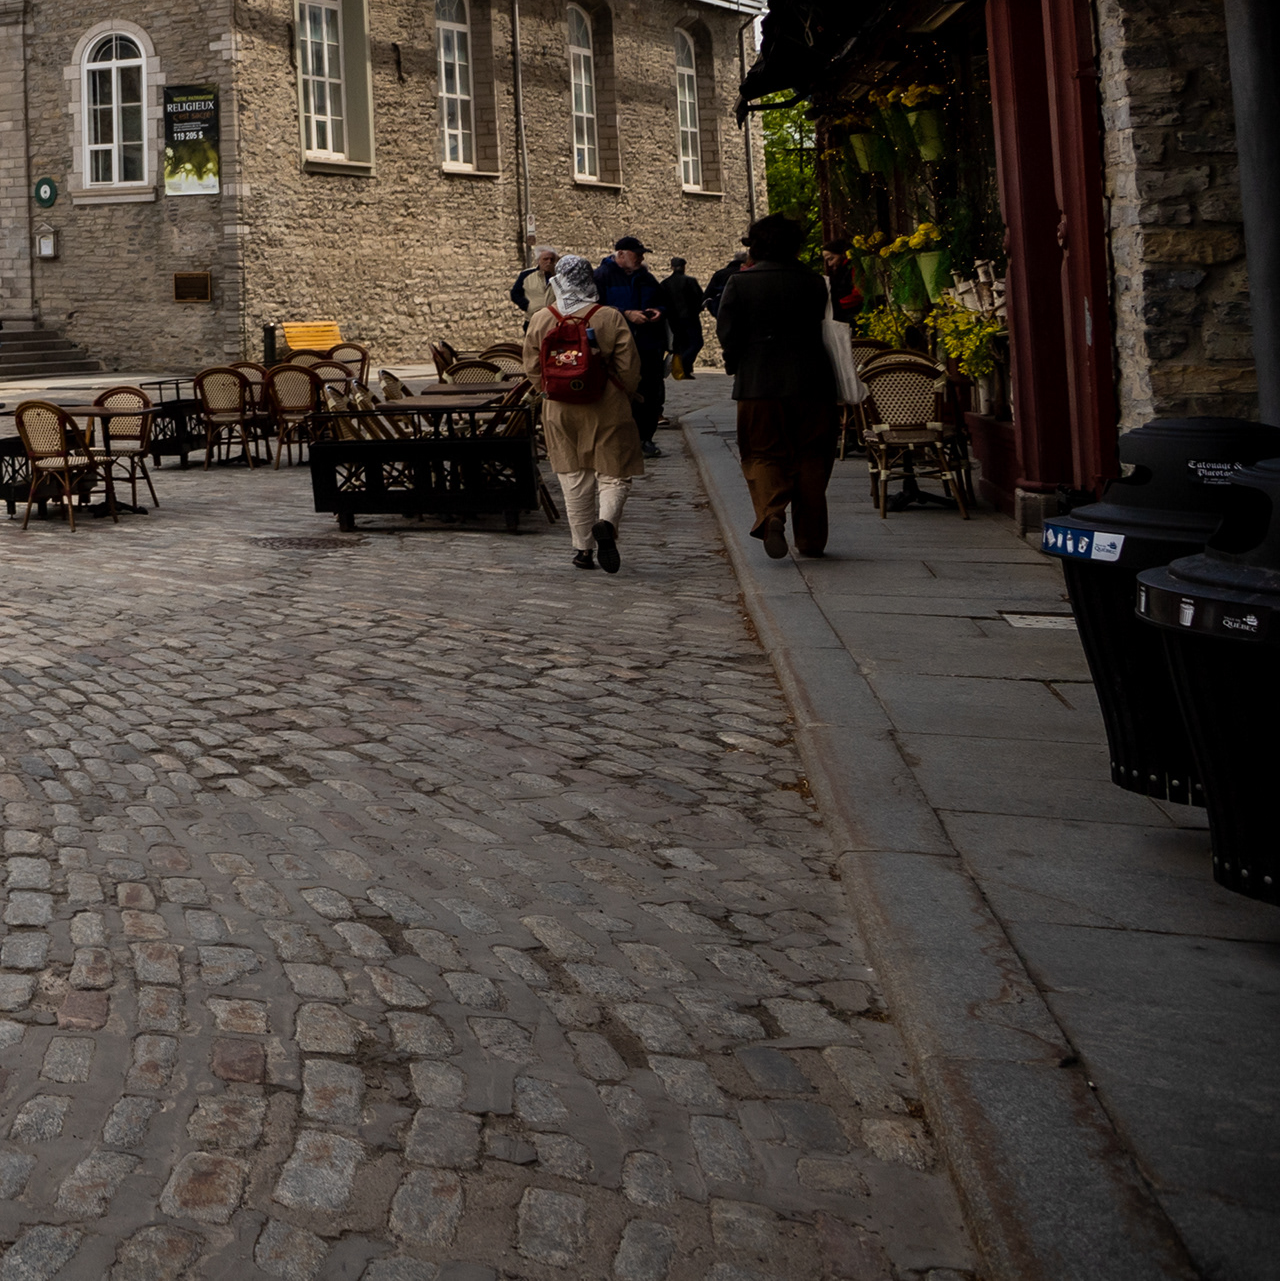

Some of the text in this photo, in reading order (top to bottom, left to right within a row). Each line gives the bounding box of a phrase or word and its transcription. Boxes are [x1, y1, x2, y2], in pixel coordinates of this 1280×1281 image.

[167, 101, 215, 113] RELIGIEUX
[173, 132, 185, 141] 119
[1187, 459, 1243, 470] Tatouage &
